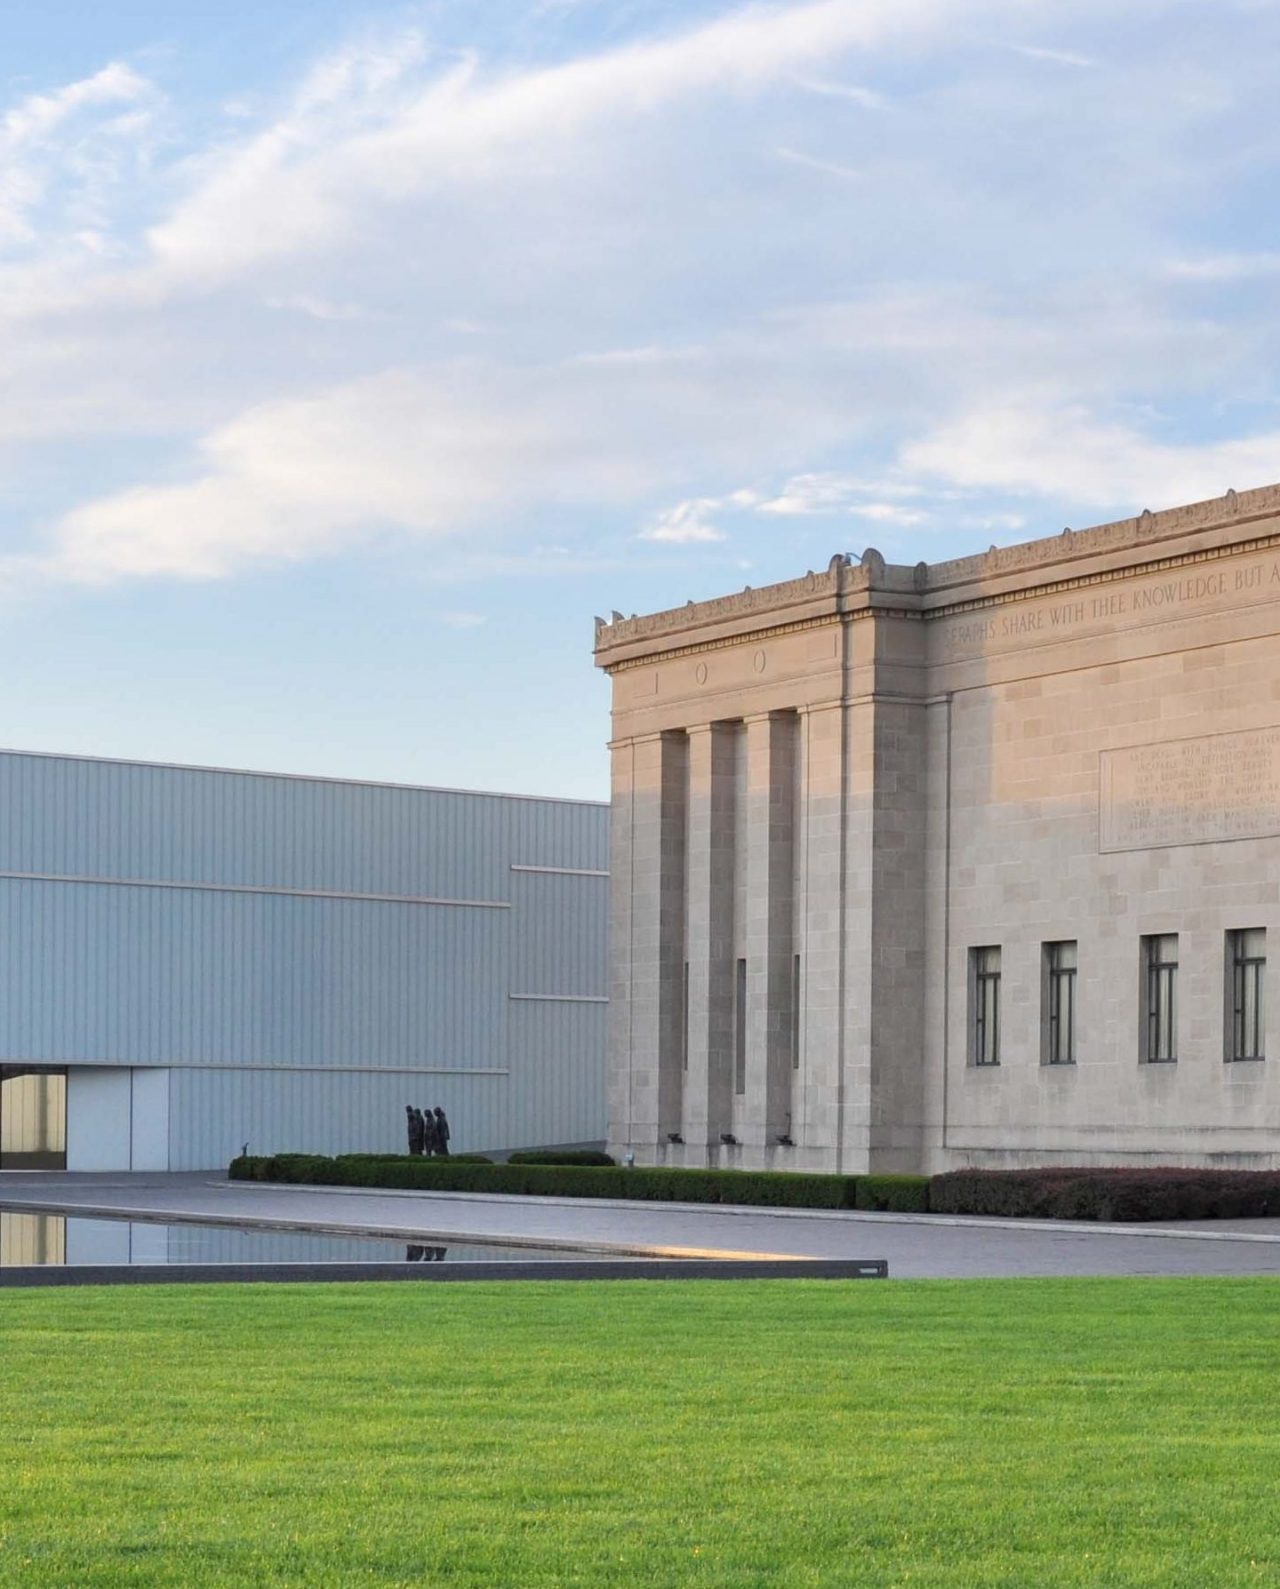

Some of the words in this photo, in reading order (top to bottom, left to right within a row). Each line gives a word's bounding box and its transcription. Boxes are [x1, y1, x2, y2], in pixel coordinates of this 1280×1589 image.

[1001, 611, 1043, 636] SHARE
[1050, 601, 1084, 626] WITH
[1092, 593, 1126, 619] THEE
[1133, 574, 1227, 611] KNOWLEDGE
[1234, 564, 1264, 590] BUT
